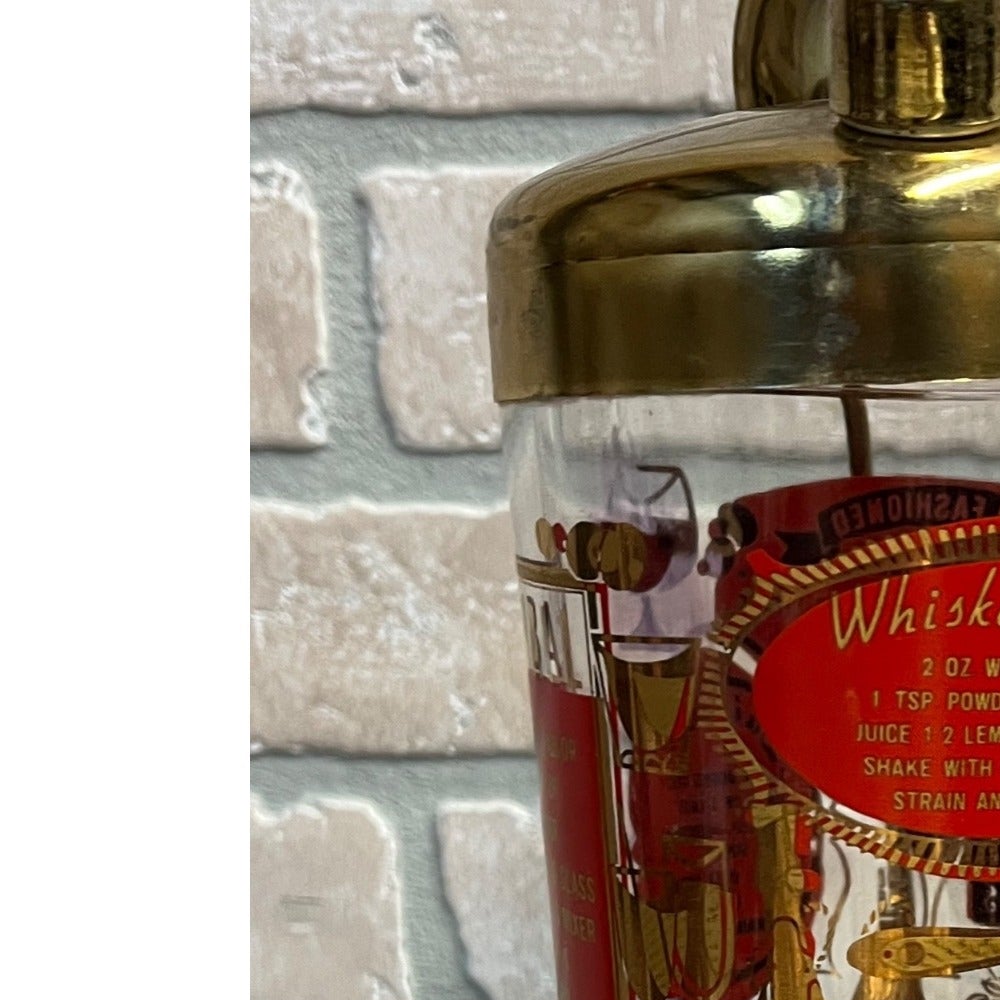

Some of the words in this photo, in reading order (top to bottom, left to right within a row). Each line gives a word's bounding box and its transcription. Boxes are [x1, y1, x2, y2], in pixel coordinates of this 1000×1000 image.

[922, 657, 934, 677] 2
[945, 657, 972, 677] OZ
[872, 690, 879, 708] 1
[895, 690, 934, 711] TSP
[856, 723, 911, 744] JUICE
[863, 756, 932, 777] SHAKE
[943, 758, 993, 777] WITH
[893, 791, 966, 811] STRAIN
